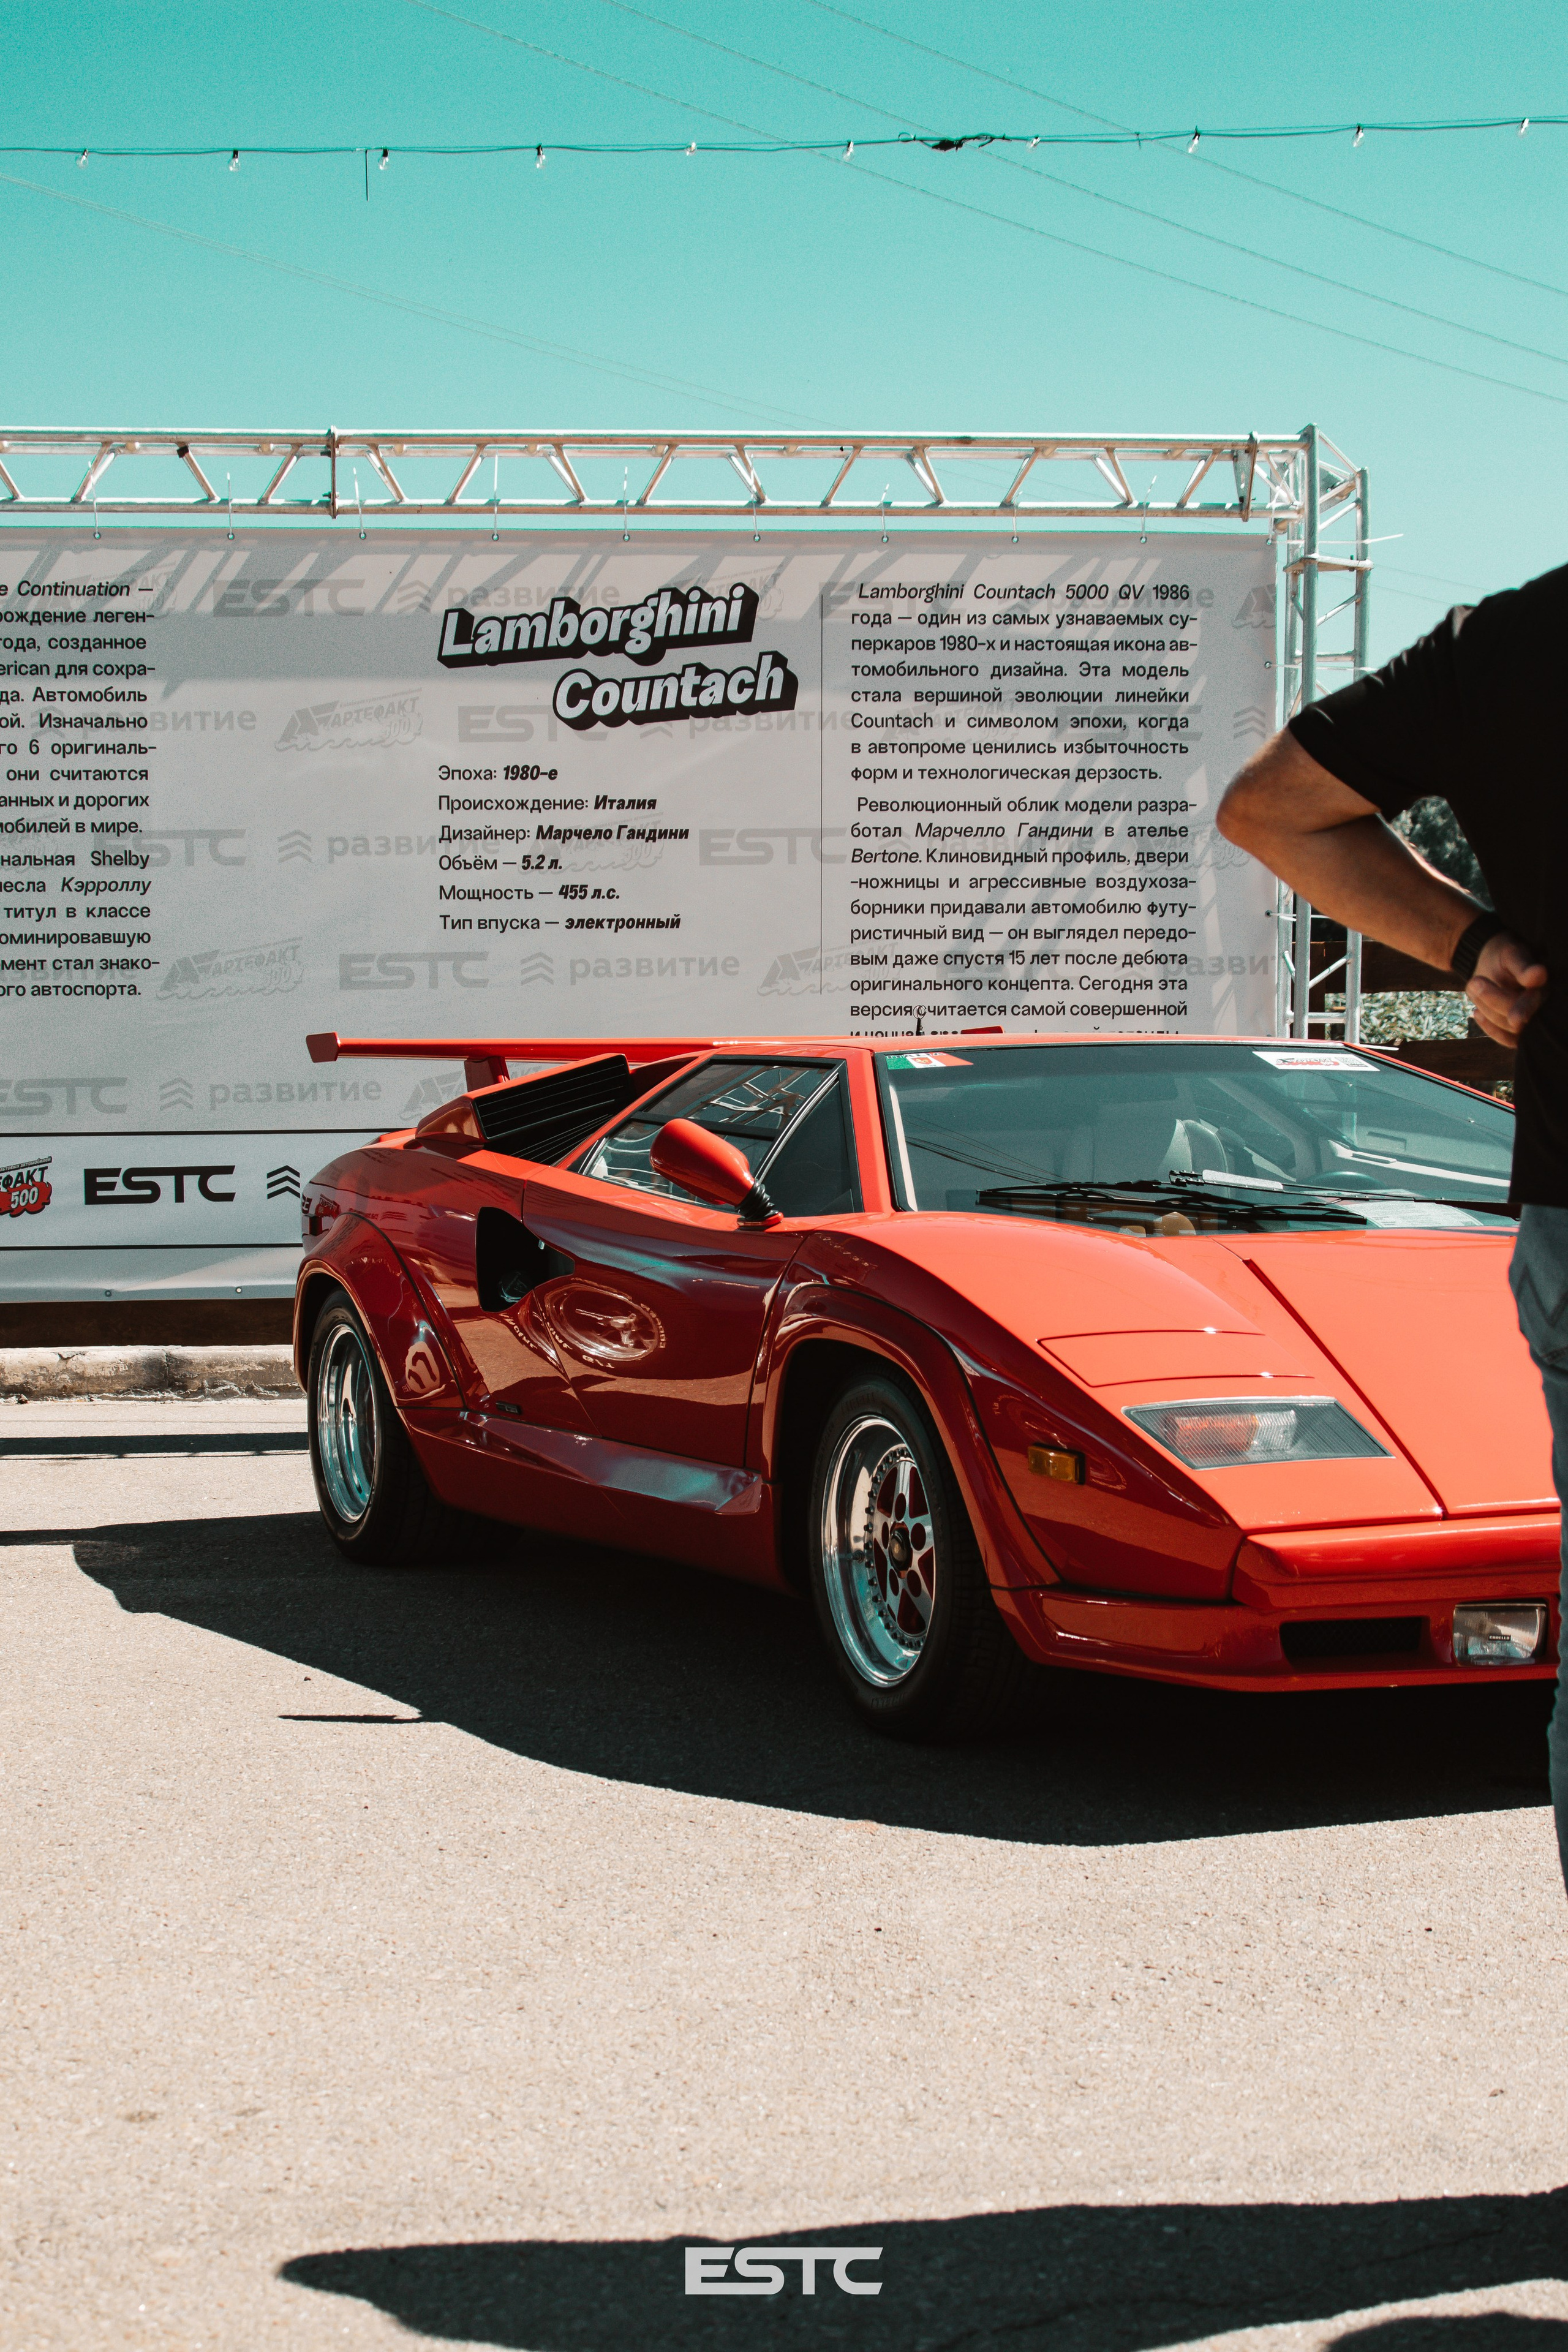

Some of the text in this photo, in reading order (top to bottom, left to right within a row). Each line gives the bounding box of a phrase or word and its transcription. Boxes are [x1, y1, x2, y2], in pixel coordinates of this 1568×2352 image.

[17, 579, 130, 597] Continuation
[213, 579, 366, 617] ESTC
[447, 583, 620, 612] развитие
[858, 582, 1190, 603] Lamborghini Countach 5000 QV 1986
[92, 611, 155, 624] леген-
[437, 582, 759, 668] Lamborghini
[851, 612, 1197, 630] года один из самых узнаваемых су-
[47, 637, 147, 653] созданное
[851, 635, 1197, 655] перкаров 1980-х и настоящая икона ав-
[0, 660, 156, 680] erican для сохра-
[851, 660, 1189, 680] томобильного дизайна. Эта модель
[0, 685, 148, 706] да. Автомобиль
[552, 650, 799, 731] Countach
[851, 687, 1189, 706] стала вершиной эволюции линейки
[0, 712, 148, 729] ой. Изначально
[851, 712, 1189, 732] Countach и символом эпохи, когда
[29, 739, 40, 755] 6
[51, 742, 157, 759] оригиналь-
[851, 737, 1189, 758] в автопроме ценились избыточность
[6, 769, 148, 781] они считаются
[438, 764, 558, 781] Эпоха: 1980-е
[851, 767, 1162, 783] форм и технологическая дерзость.
[0, 795, 149, 811] анных и дорогих
[439, 794, 657, 815] Происхождение: Италия
[858, 796, 1197, 816] Революционный облик модели разра-
[75, 821, 86, 833] в
[91, 821, 143, 837] мире.
[439, 824, 690, 844] Дизайнер: Марчело Гандини
[851, 821, 1189, 842] ботал Марчелло Гандини в ателье
[698, 827, 848, 866] ESTC
[0, 850, 150, 870] нальная Shelby
[439, 854, 562, 870] Объём 5.2 л.
[851, 848, 1189, 867] Bertone. Клиновидный профиль, двери
[61, 876, 152, 896] Кэрроллу
[439, 884, 620, 902] Мощность 455 л.с.
[850, 876, 1197, 892] -ножницы и агрессивные воздухоза-
[3, 906, 151, 922] титул в классе
[850, 898, 1197, 918] борники придавали автомобилю футу-
[439, 913, 681, 933] Тип впуска электронный
[0, 932, 151, 948] оминировавшую
[851, 925, 1196, 944] ристичный вид он выглядел передо-
[0, 958, 160, 971] мент стал знако-
[850, 949, 1188, 969] вым даже спустя 15 лет после дебюта
[339, 951, 489, 990] ESTC
[569, 955, 741, 986] развитие
[31, 984, 141, 1000] автоспорта.
[850, 975, 1188, 995] оригинального концепта. Сегодня эта
[850, 1000, 1189, 1021] версия считается самой совершенной
[208, 1079, 382, 1110] развитие
[84, 1165, 236, 1205] ESTC
[10, 1186, 39, 1208] 500
